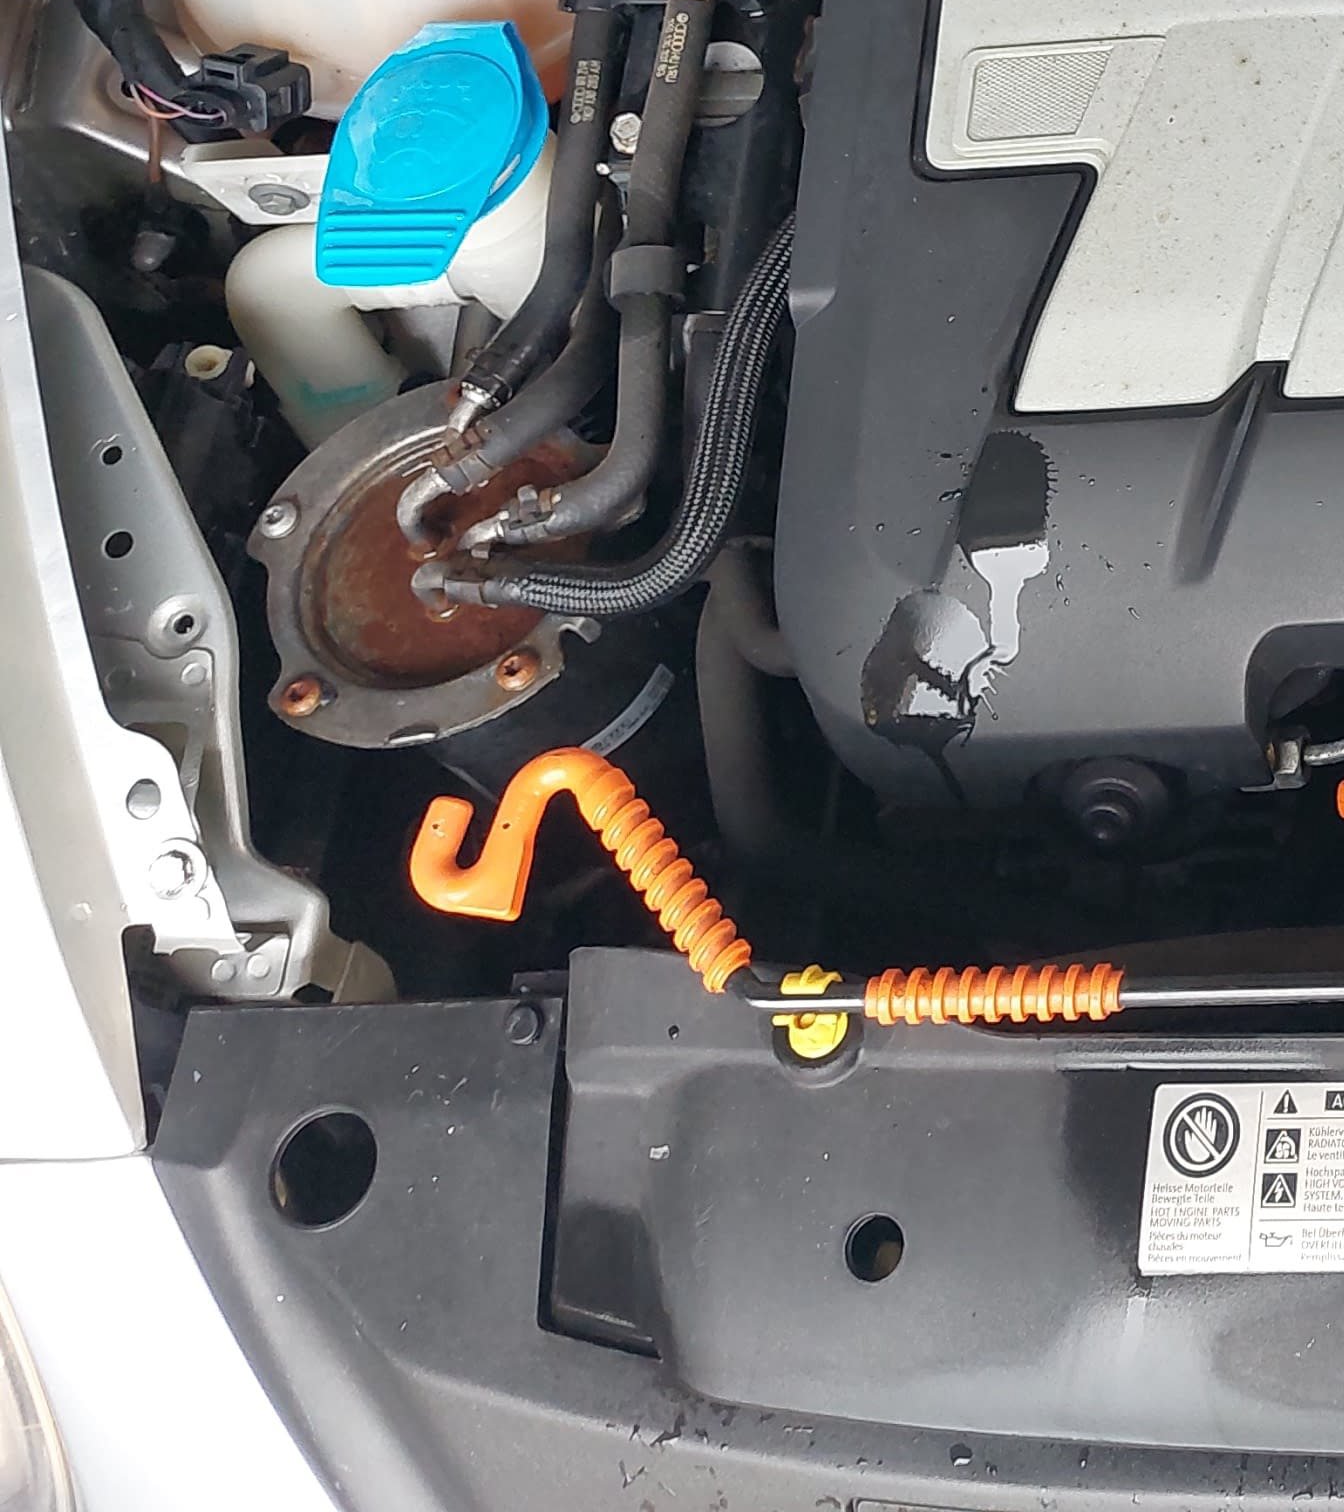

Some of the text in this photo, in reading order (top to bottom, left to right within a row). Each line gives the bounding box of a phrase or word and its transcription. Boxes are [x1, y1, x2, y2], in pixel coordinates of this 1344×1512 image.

[1306, 1150, 1317, 1160] Le
[1152, 1183, 1234, 1193] Heisse Motorteile
[1304, 1178, 1330, 1189] HIGH
[1151, 1194, 1215, 1206] Bewegte Teile
[1150, 1207, 1170, 1217] HOT
[1212, 1207, 1240, 1217] PARTS
[1303, 1202, 1332, 1213] Haute
[1149, 1218, 1191, 1228] MOVING
